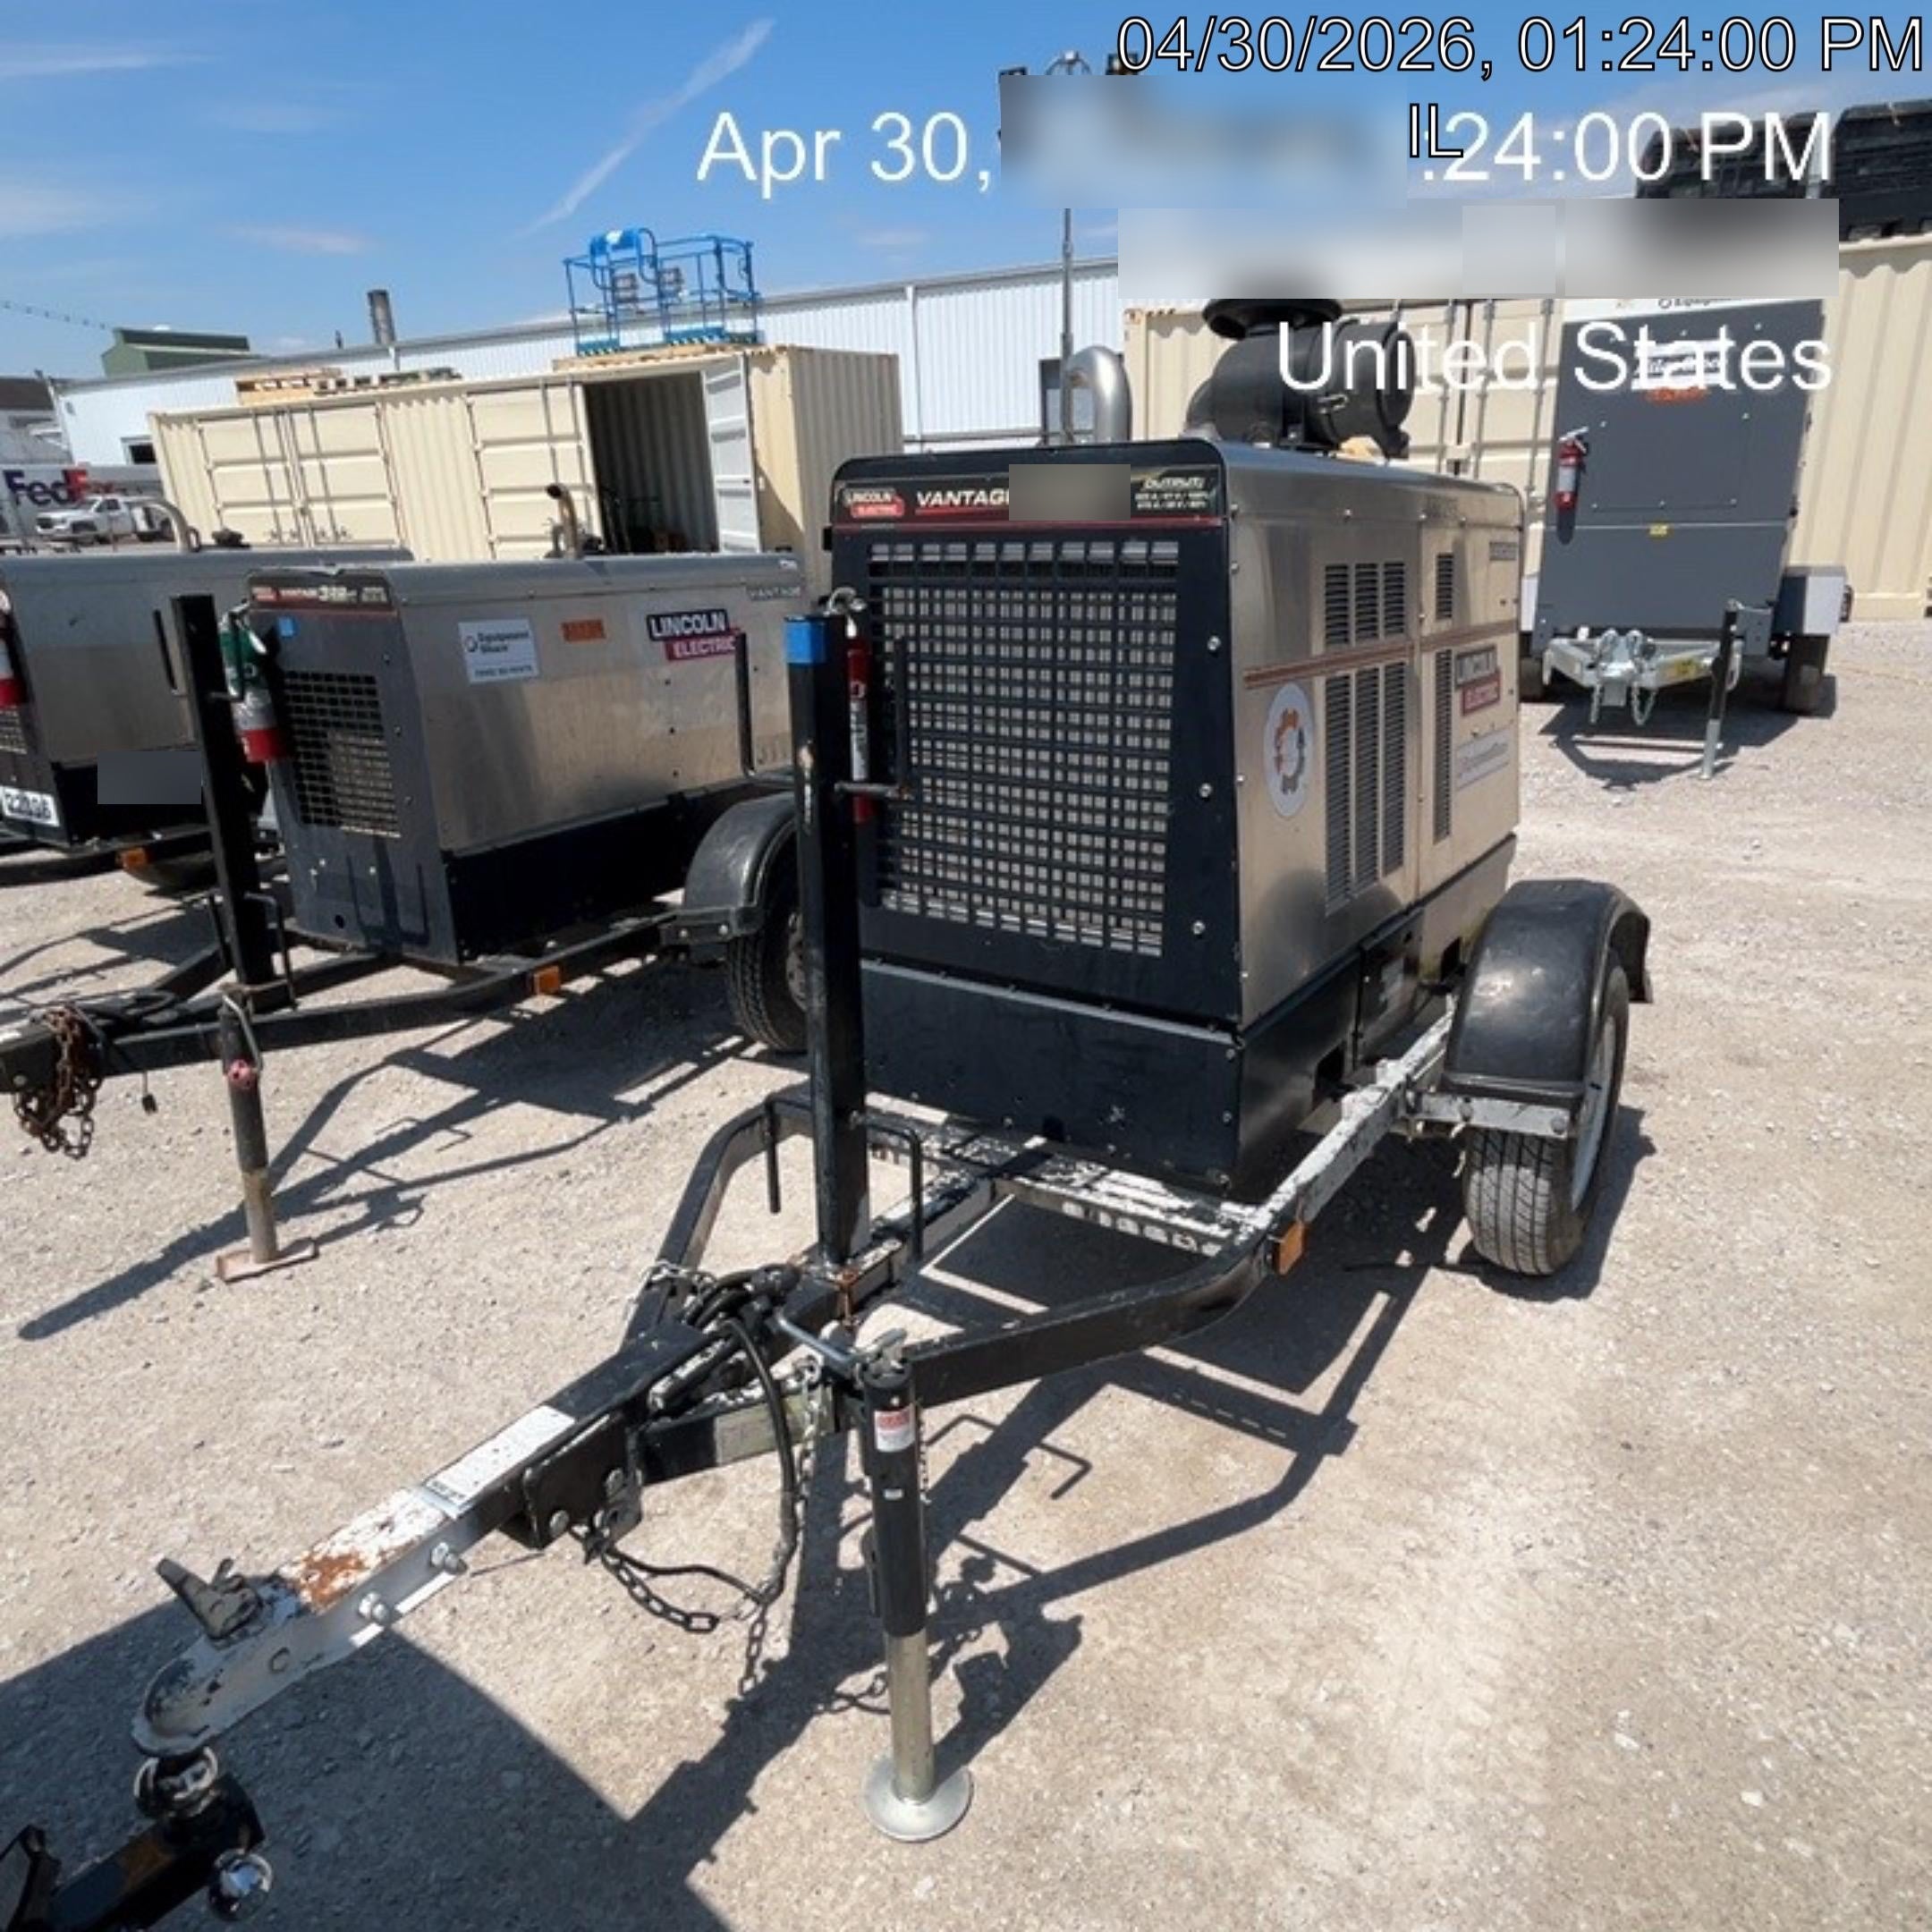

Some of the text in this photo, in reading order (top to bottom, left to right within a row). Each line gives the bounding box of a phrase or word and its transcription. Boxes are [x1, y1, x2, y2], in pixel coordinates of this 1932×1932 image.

[916, 487, 1009, 507] VANTAG
[649, 612, 726, 639] LINCOLN
[672, 635, 737, 659] ELECTRIC
